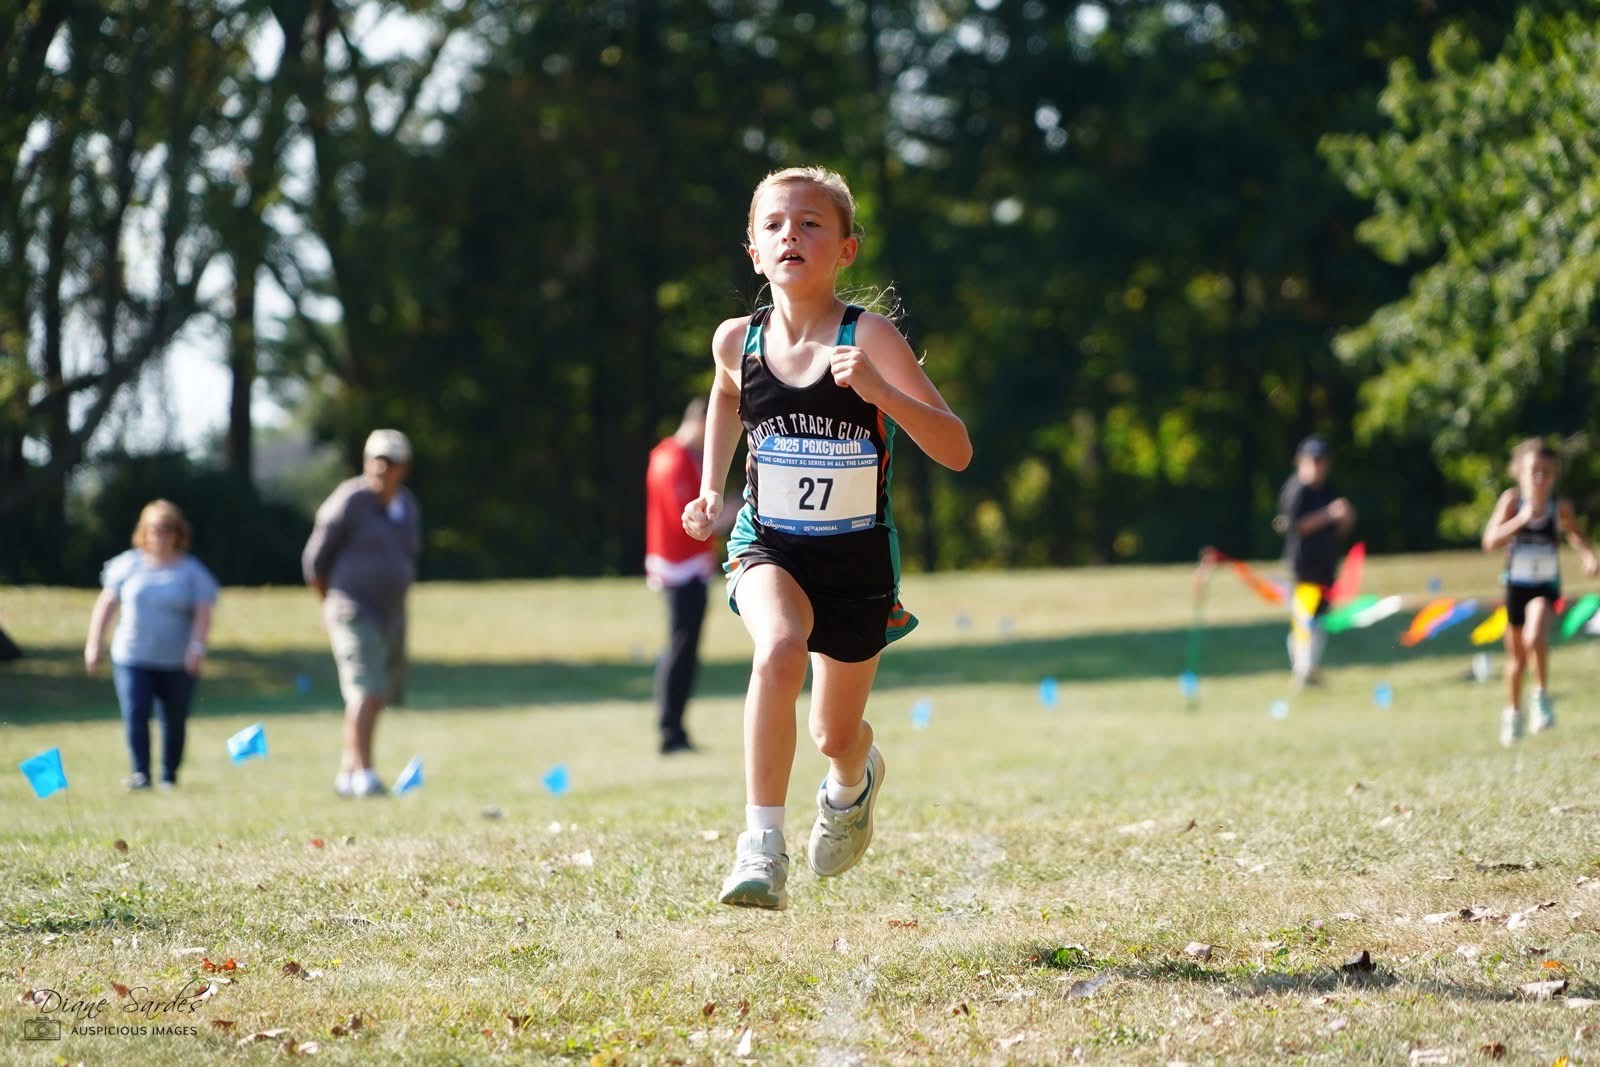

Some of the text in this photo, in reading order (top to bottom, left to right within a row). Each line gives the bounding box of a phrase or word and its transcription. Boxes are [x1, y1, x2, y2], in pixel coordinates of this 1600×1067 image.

[790, 413, 834, 437] TRACK
[773, 437, 861, 455] 2025 PGXCyouth
[773, 457, 798, 465] GREATEST
[798, 477, 834, 511] 27
[815, 524, 838, 532] ANNUAL
